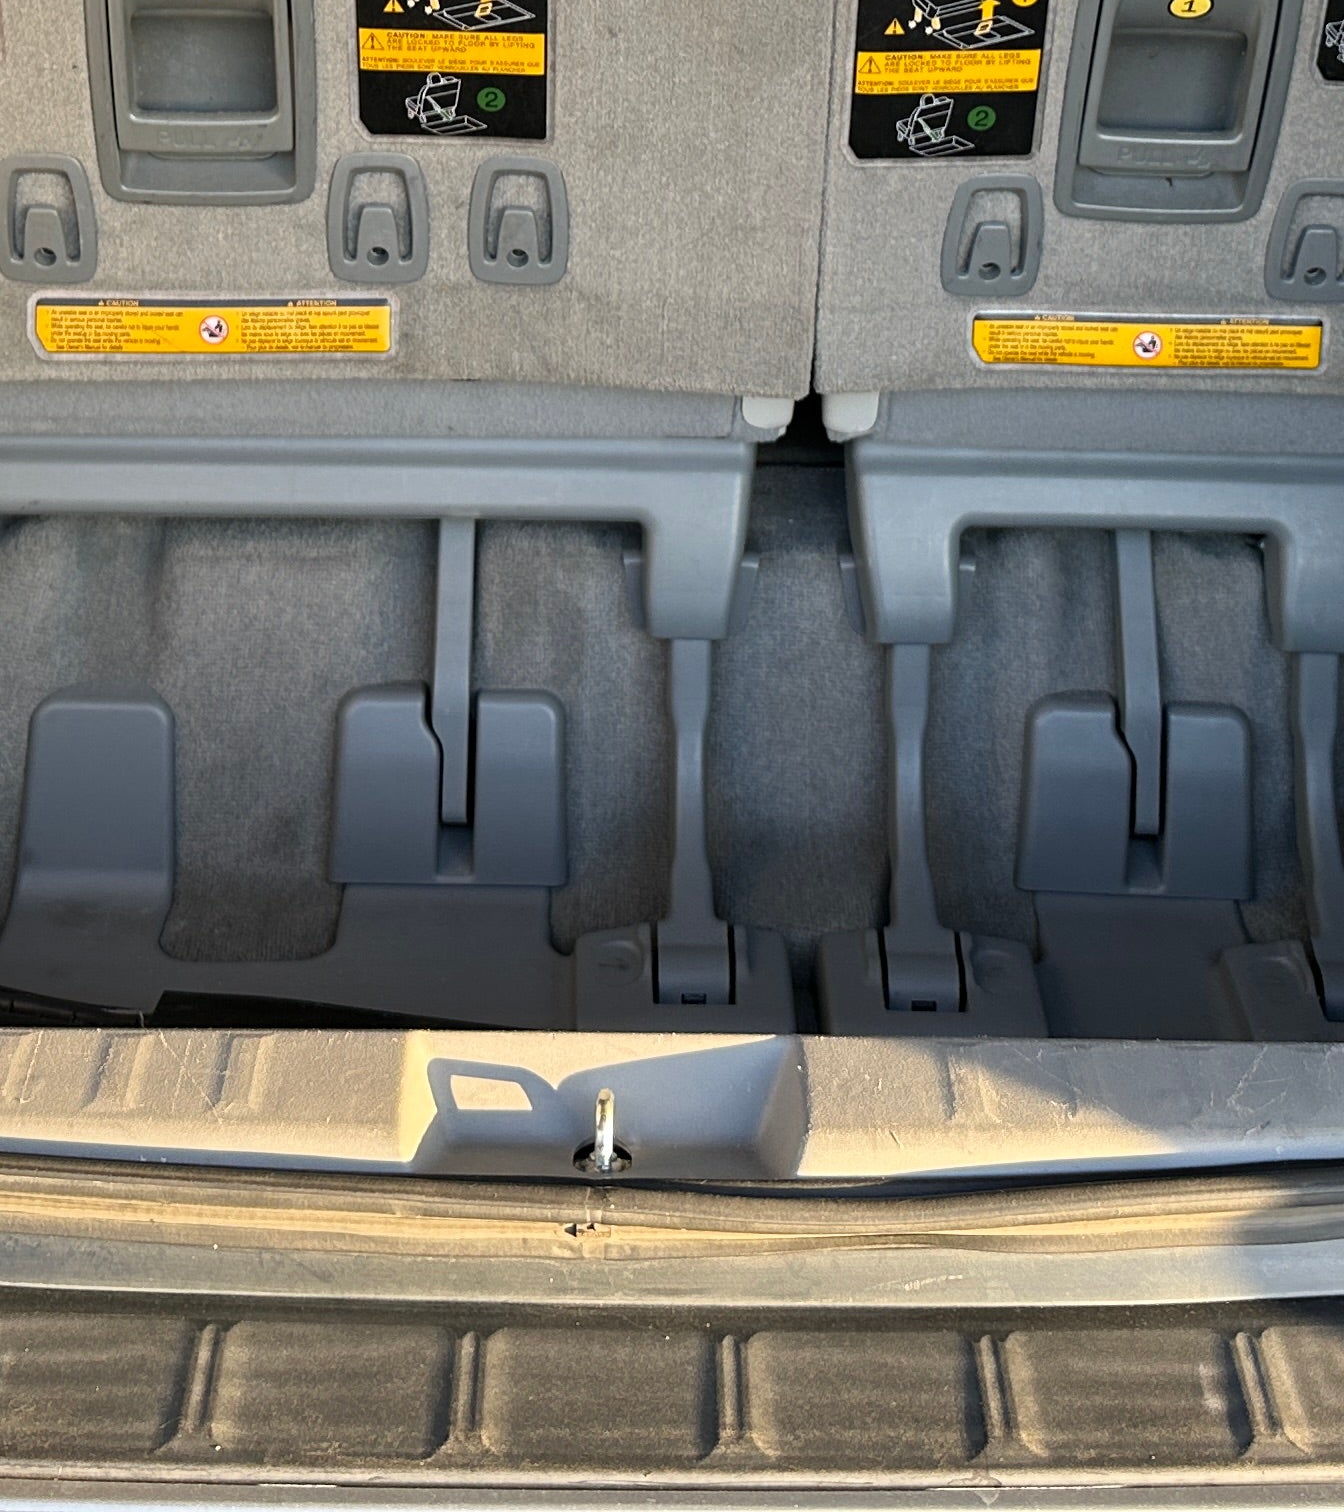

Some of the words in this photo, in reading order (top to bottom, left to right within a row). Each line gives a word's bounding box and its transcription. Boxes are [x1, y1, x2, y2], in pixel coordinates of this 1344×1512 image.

[484, 91, 498, 108] 2
[974, 110, 988, 127] 2
[106, 299, 139, 307] CAUTION
[296, 299, 337, 307] ATTENTION
